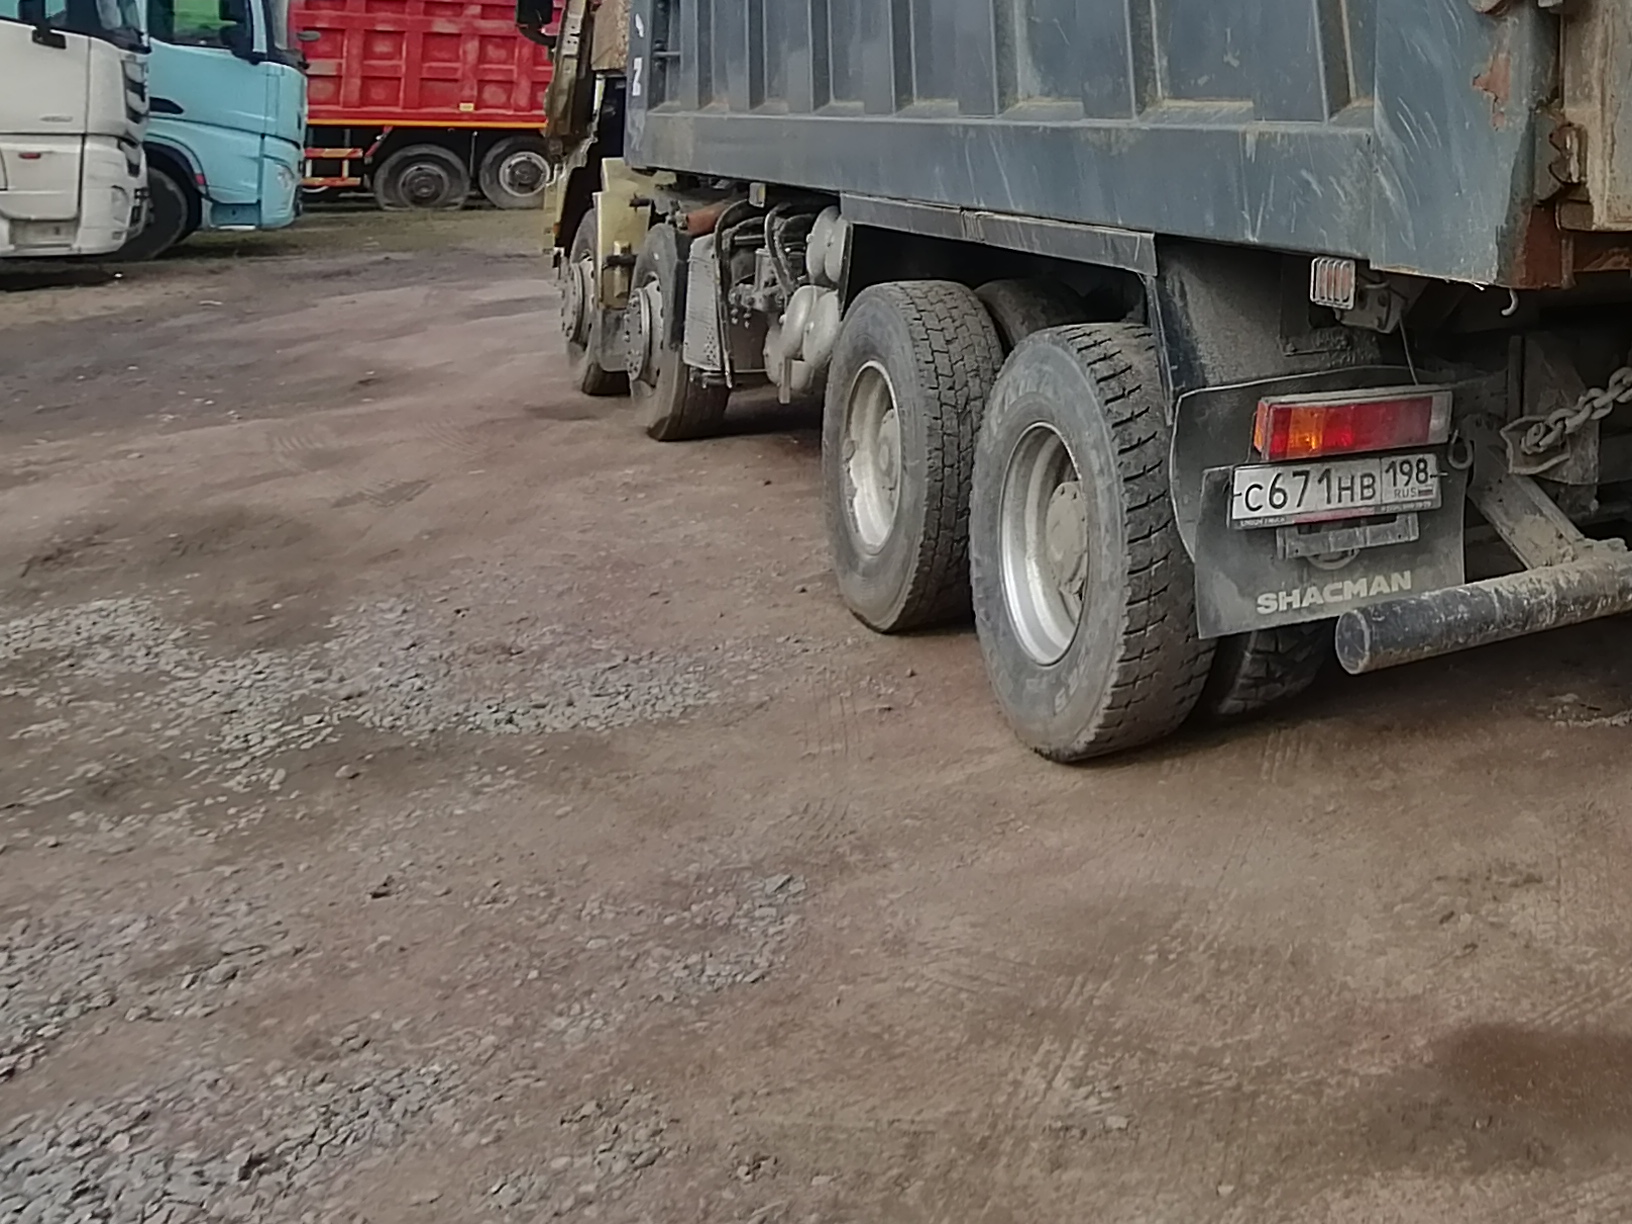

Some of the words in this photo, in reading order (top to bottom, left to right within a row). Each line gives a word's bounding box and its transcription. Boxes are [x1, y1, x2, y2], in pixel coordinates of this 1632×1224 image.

[1385, 458, 1429, 487] 198
[1394, 488, 1417, 499] RUS
[1256, 570, 1412, 615] SHACMAN
